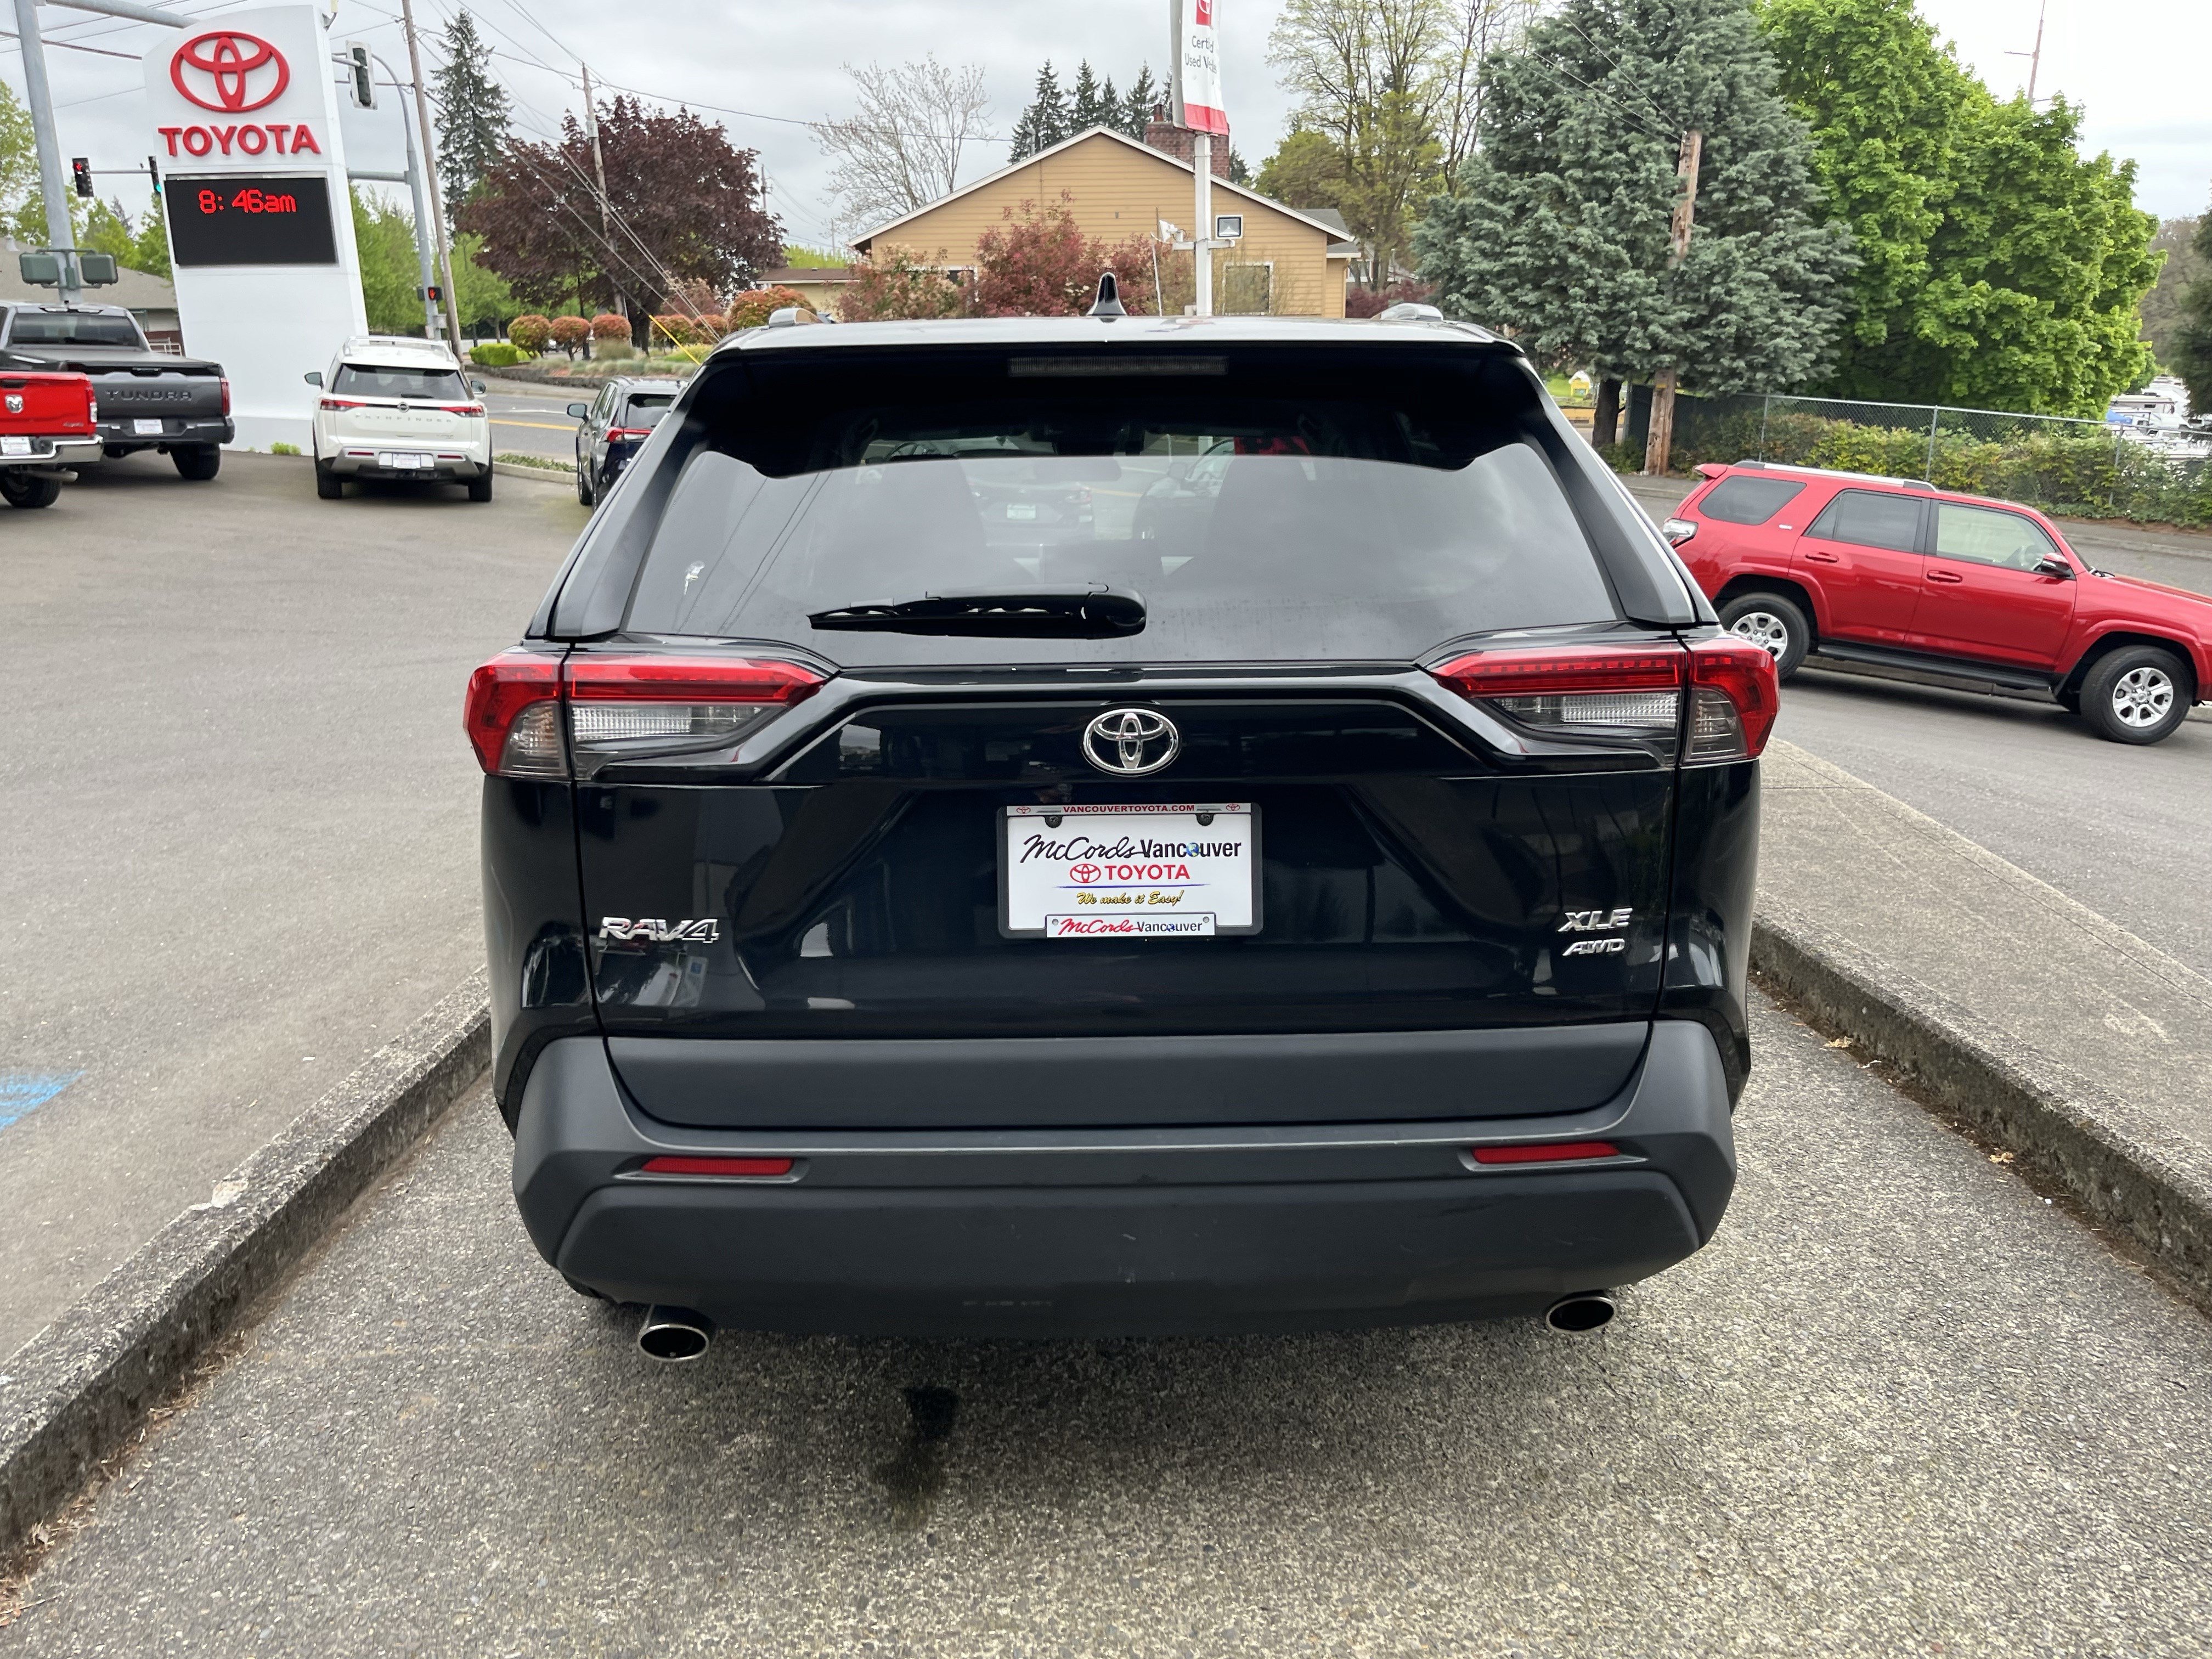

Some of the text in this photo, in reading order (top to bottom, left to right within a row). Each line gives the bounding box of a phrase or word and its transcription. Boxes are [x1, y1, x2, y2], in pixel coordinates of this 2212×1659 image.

[1184, 53, 1201, 68] Used
[157, 124, 322, 157] TOYOTA
[106, 390, 192, 401] TUNDRA
[1063, 804, 1195, 813] VANCOUVERTOYOTA.COM
[1104, 864, 1190, 880] TOYOTA
[1076, 889, 1184, 906] We make it Easy!
[1558, 907, 1633, 932] XLE
[599, 917, 720, 944] RAV4
[1562, 938, 1625, 956] AWD
